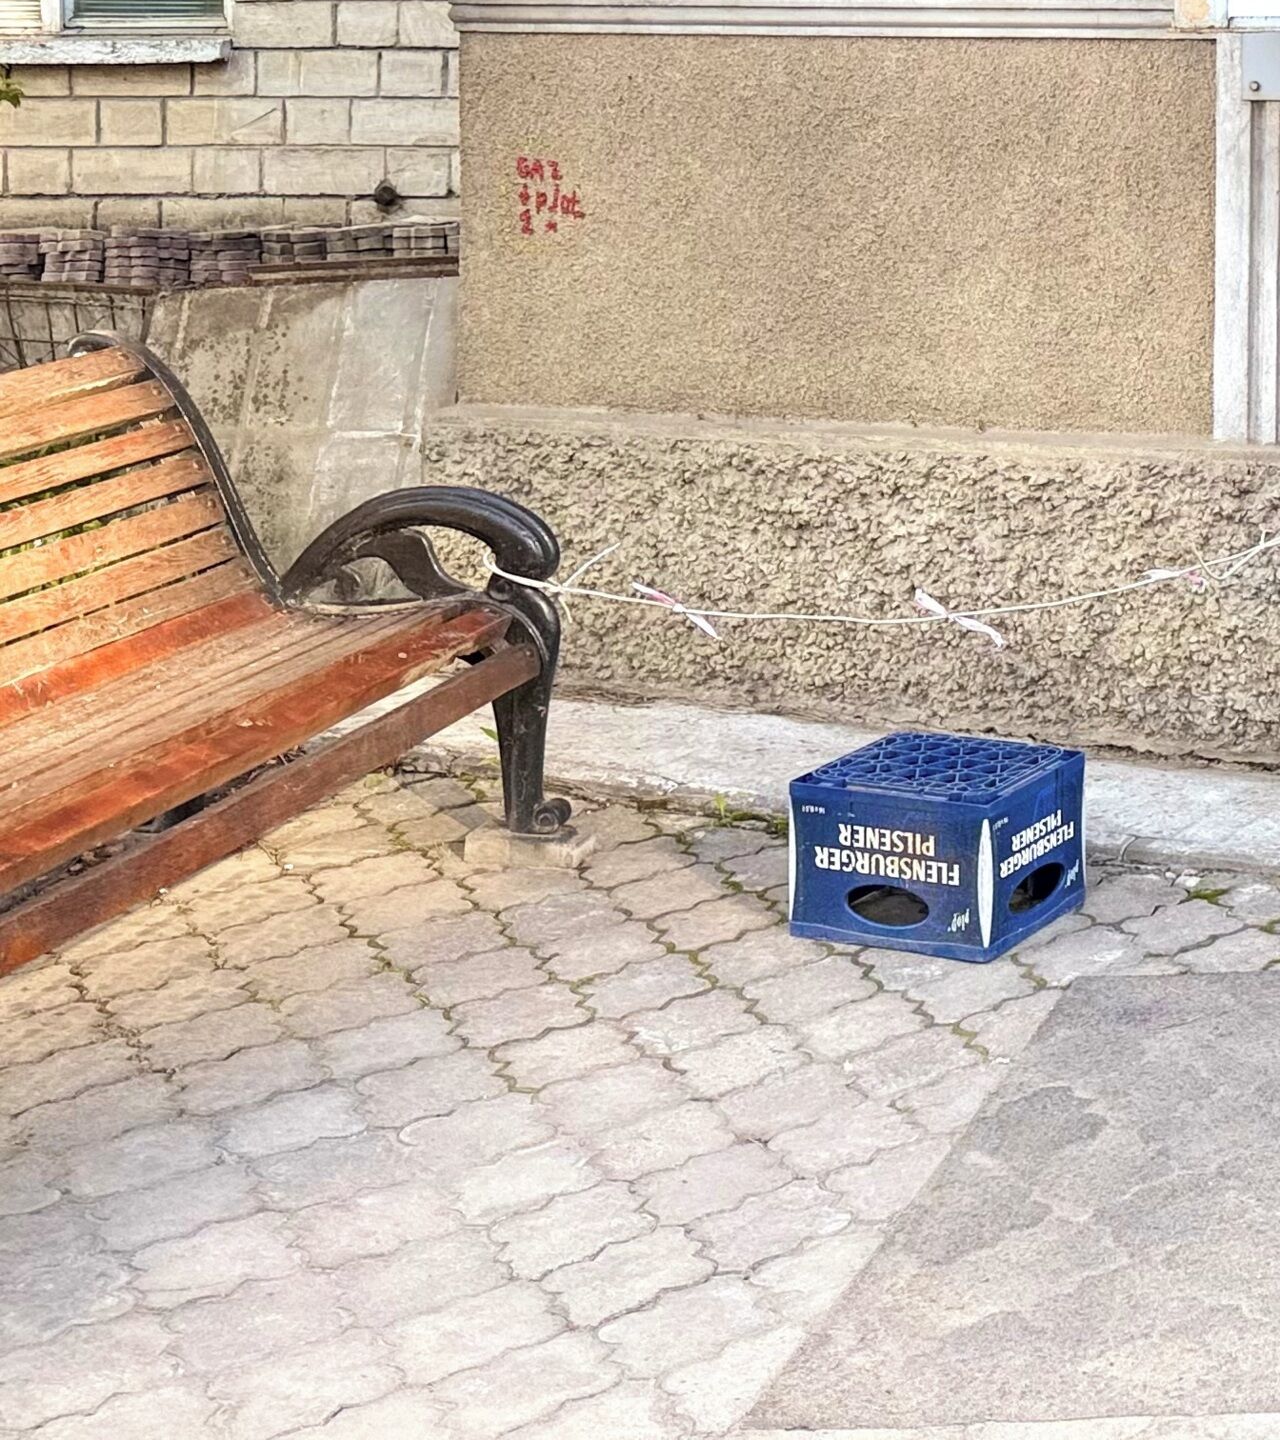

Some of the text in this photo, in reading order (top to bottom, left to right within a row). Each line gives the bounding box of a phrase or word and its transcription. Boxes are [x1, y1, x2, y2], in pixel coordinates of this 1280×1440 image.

[838, 824, 935, 857] PILSENER
[999, 820, 1074, 879] FLENSBURGER
[1011, 809, 1062, 852] PILSENER
[814, 846, 960, 886] FLENSBURGER
